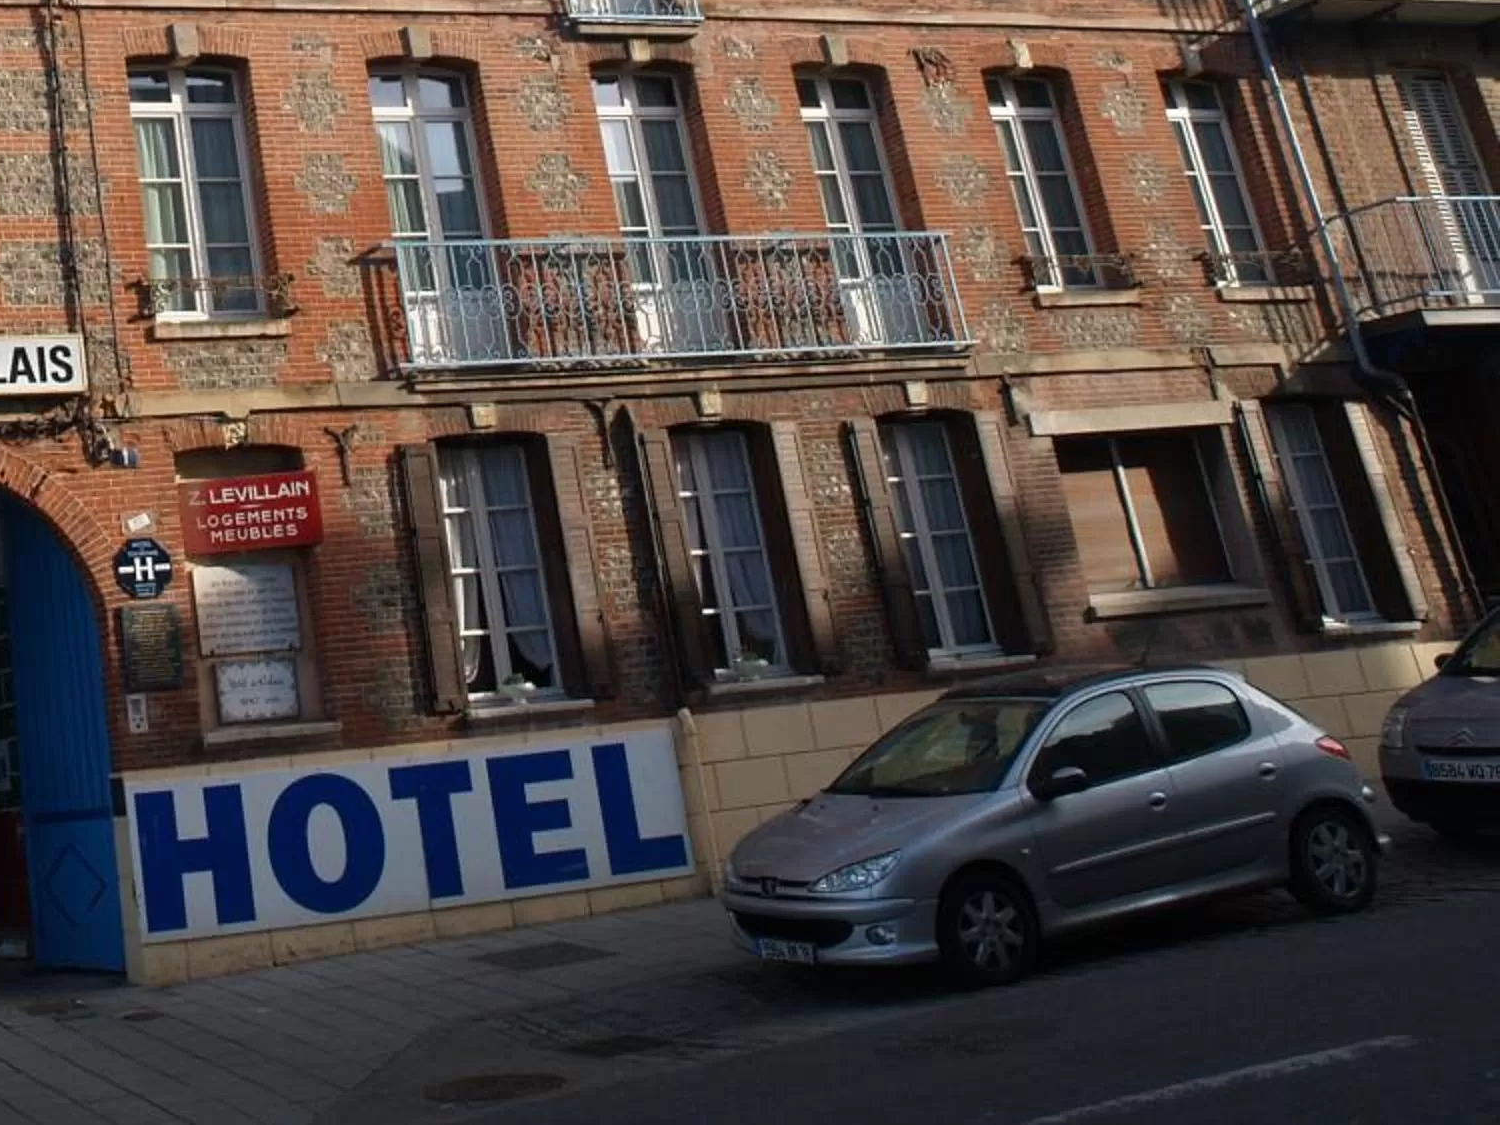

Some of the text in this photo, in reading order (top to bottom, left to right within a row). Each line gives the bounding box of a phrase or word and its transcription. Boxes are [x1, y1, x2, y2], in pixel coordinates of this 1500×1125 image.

[208, 480, 310, 505] LEVILLAIN
[196, 506, 308, 530] LOGEMENTS
[133, 556, 156, 582] H
[133, 742, 688, 934] HOTEL
